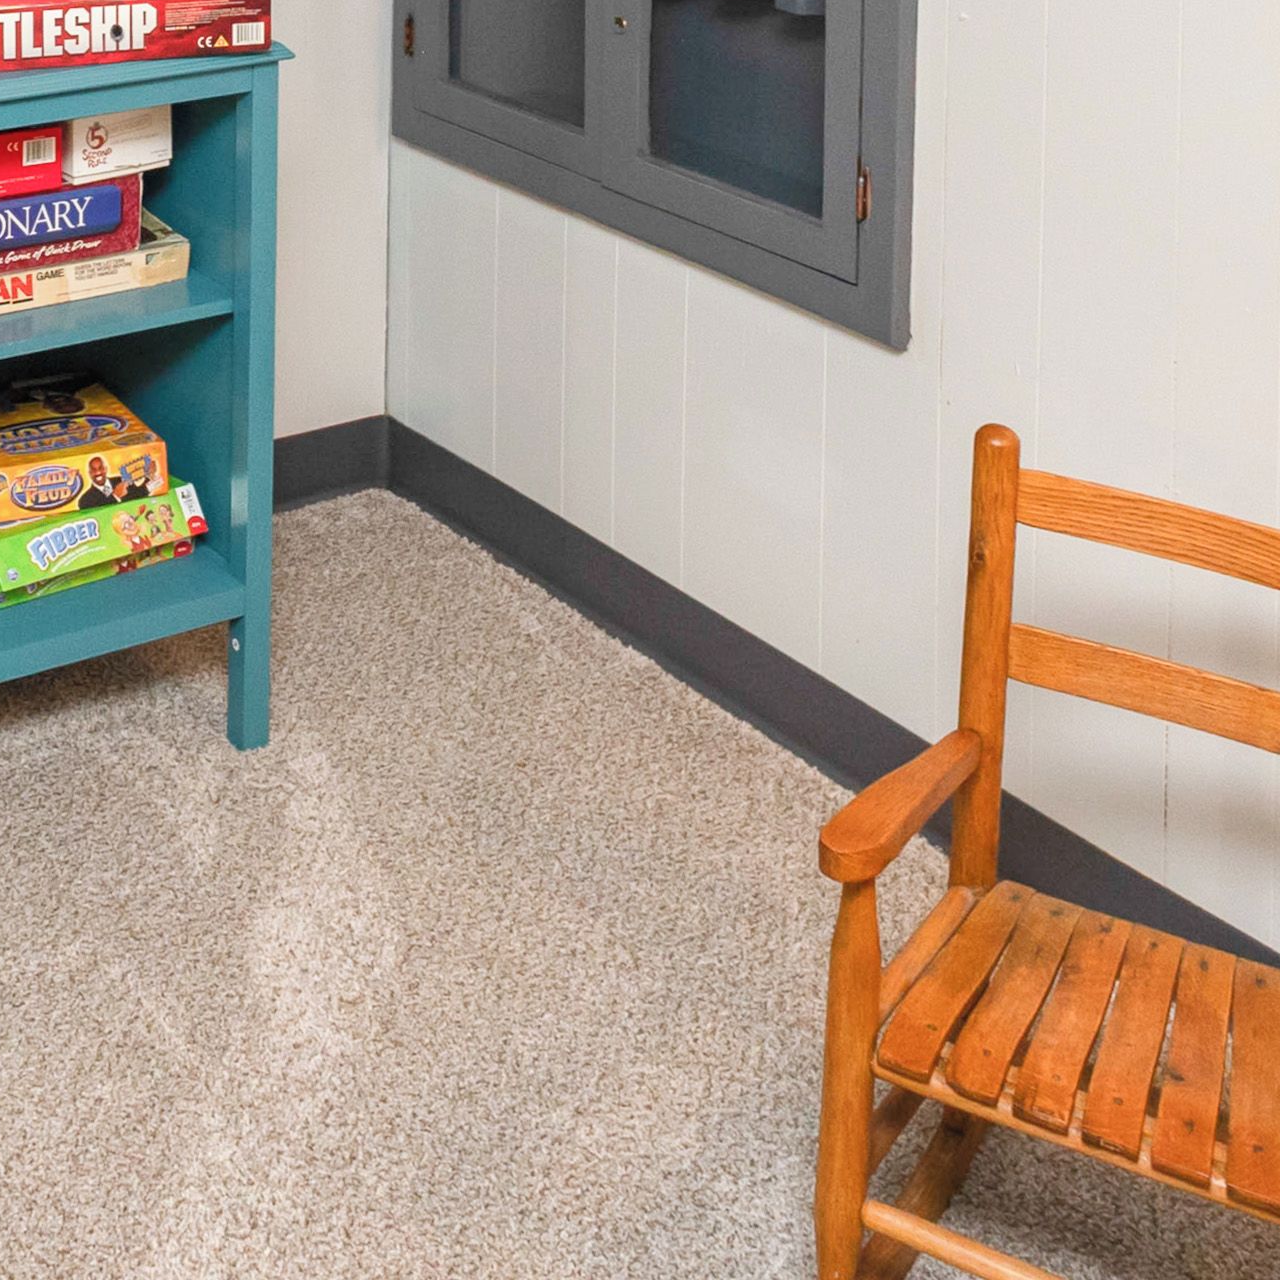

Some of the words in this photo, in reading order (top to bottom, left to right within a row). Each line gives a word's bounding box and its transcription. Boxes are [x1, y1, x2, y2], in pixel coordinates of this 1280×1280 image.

[4, 250, 32, 265] Game
[36, 268, 65, 281] GAME
[14, 468, 81, 493] FAMILY
[25, 486, 74, 508] FEUD
[28, 519, 99, 570] FIBBER
